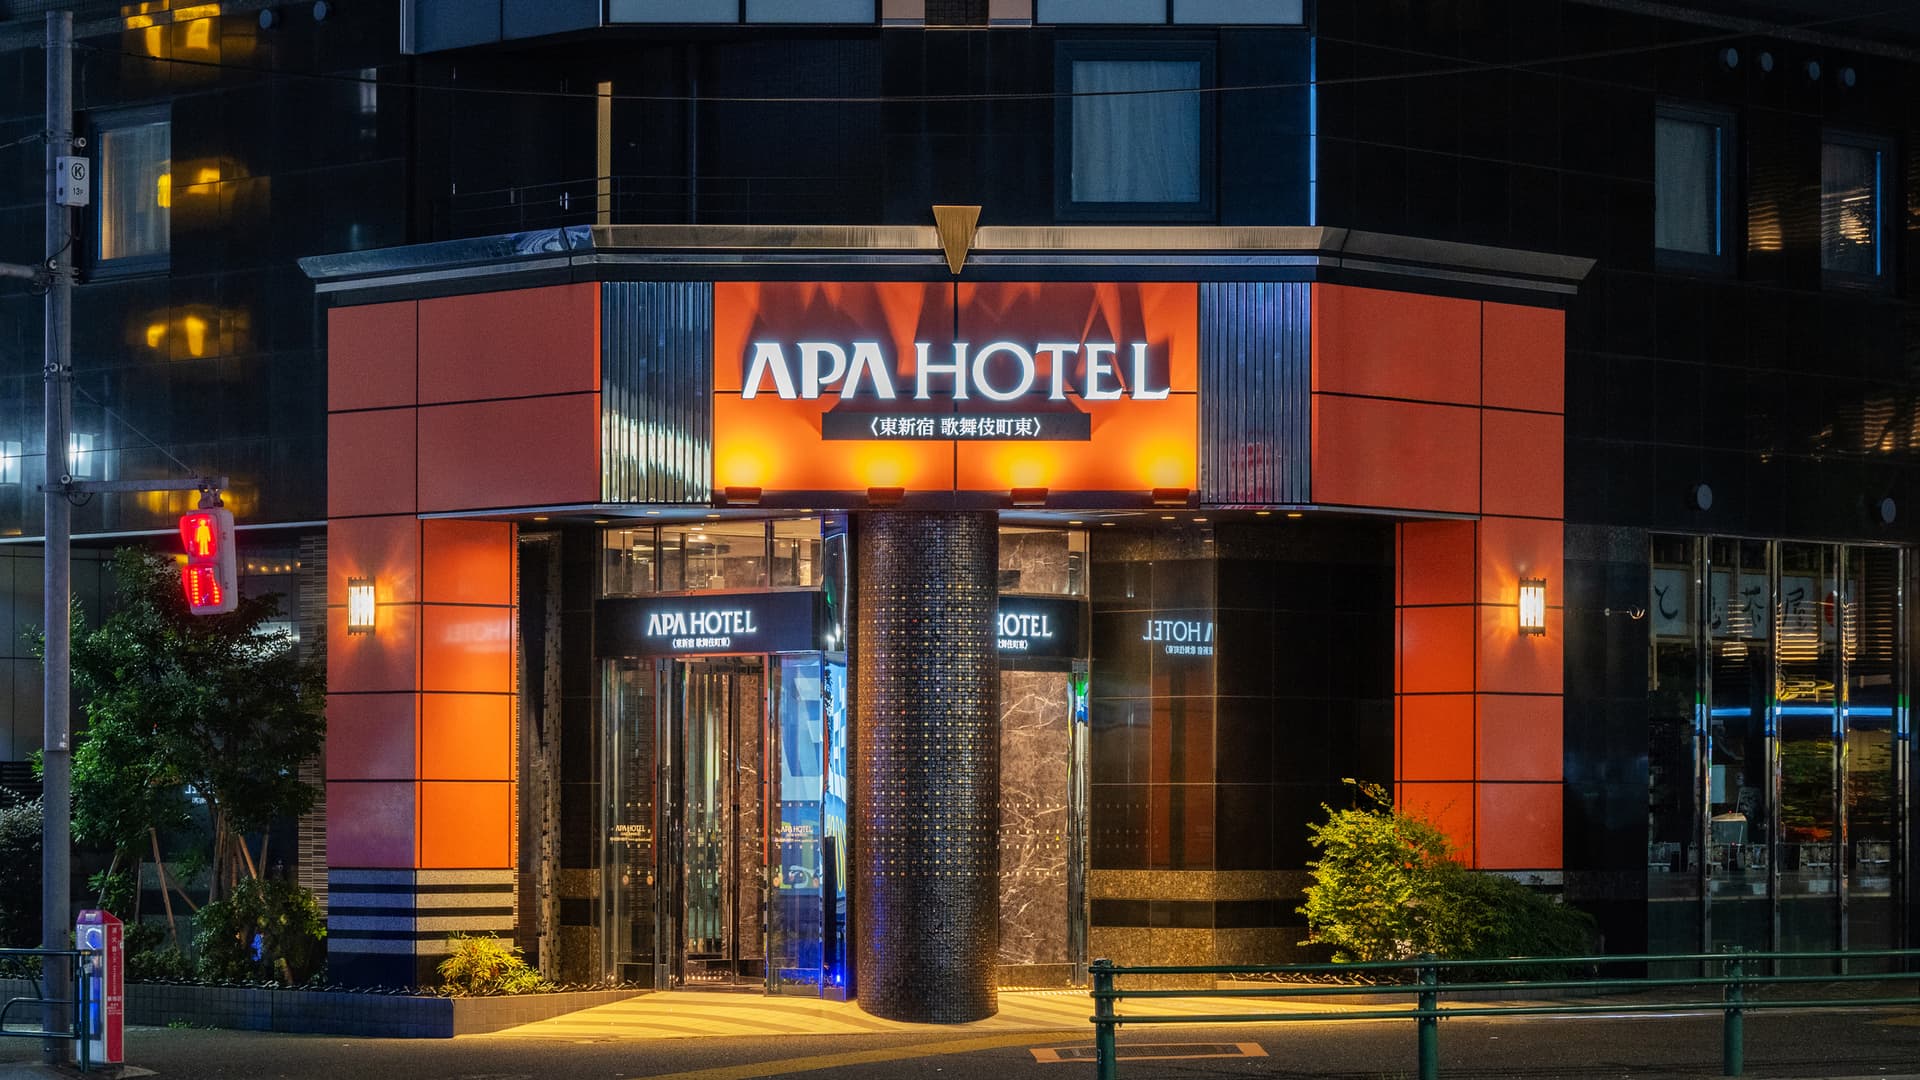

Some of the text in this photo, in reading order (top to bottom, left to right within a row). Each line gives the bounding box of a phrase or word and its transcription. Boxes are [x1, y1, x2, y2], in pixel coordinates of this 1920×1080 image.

[742, 342, 1171, 400] APA HOTEL
[647, 610, 757, 636] APA HOTEL
